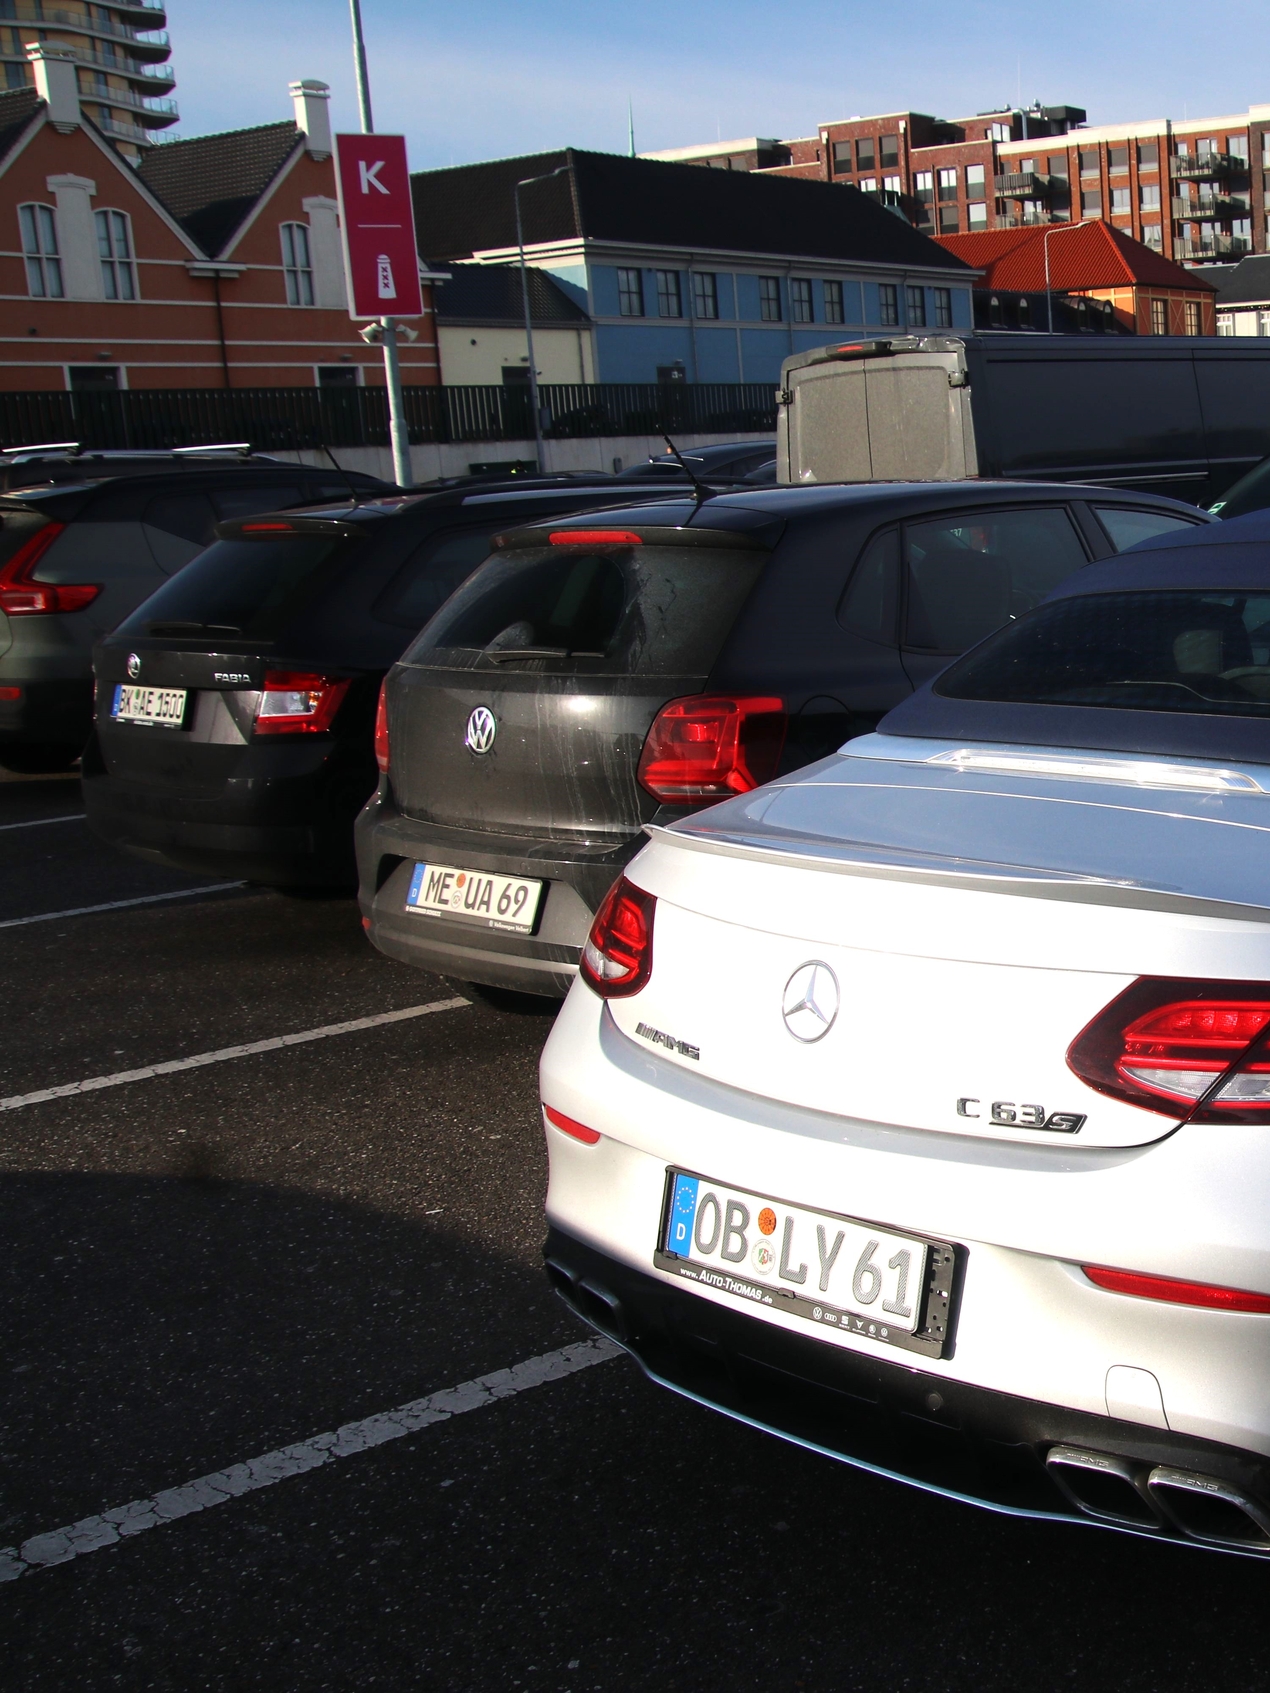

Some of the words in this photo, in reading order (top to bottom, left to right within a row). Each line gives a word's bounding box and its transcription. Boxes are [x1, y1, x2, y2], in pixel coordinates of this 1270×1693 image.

[358, 161, 391, 194] K
[214, 673, 251, 683] FABIA
[119, 689, 134, 714] BK
[138, 690, 154, 716] AE
[155, 692, 184, 719] 1500
[411, 888, 417, 898] D
[424, 870, 455, 906] ME
[463, 877, 494, 913] UA
[497, 883, 529, 918] 69
[956, 1097, 981, 1119] C
[676, 1222, 687, 1241] D
[694, 1191, 751, 1263] OB
[778, 1215, 846, 1292] LY
[851, 1239, 912, 1318] 61
